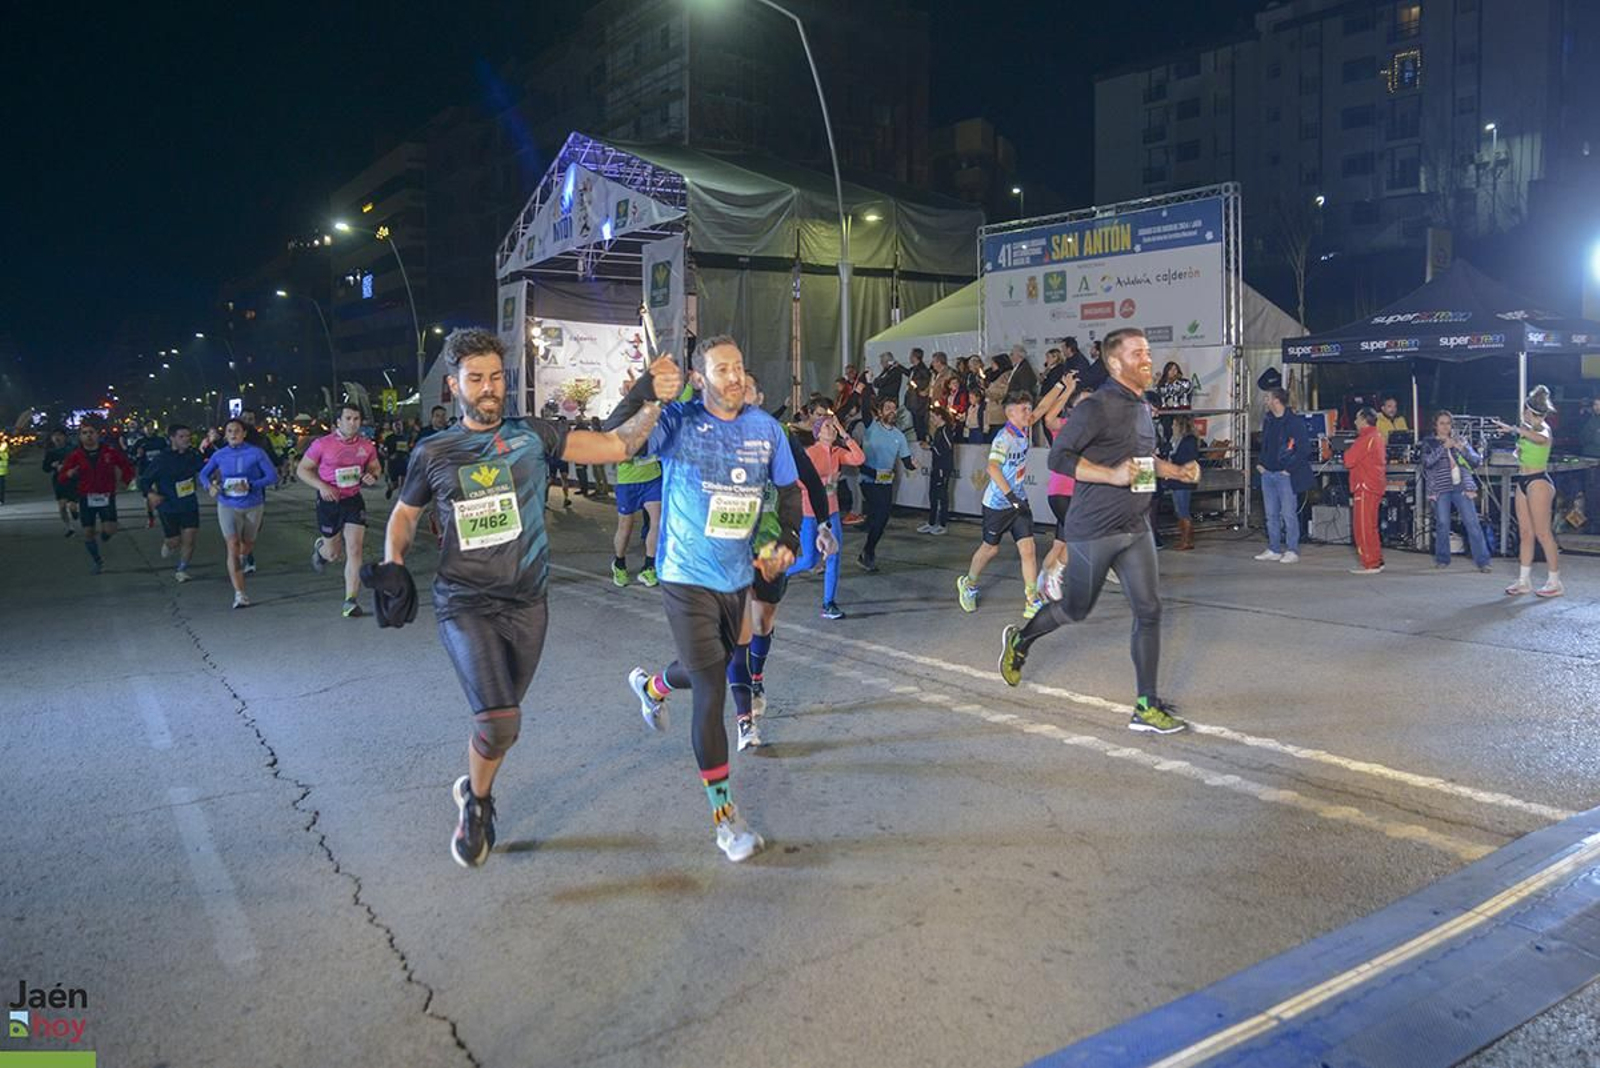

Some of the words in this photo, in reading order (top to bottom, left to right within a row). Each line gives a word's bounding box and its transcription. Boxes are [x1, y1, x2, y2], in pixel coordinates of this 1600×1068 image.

[1051, 232, 1079, 261] SAN
[1083, 219, 1132, 256] ANTÓN
[998, 244, 1013, 267] 41
[1360, 338, 1420, 351] superscreen
[1440, 332, 1505, 349] superscreen
[1288, 343, 1342, 357] superscreen
[469, 513, 508, 532] 7462
